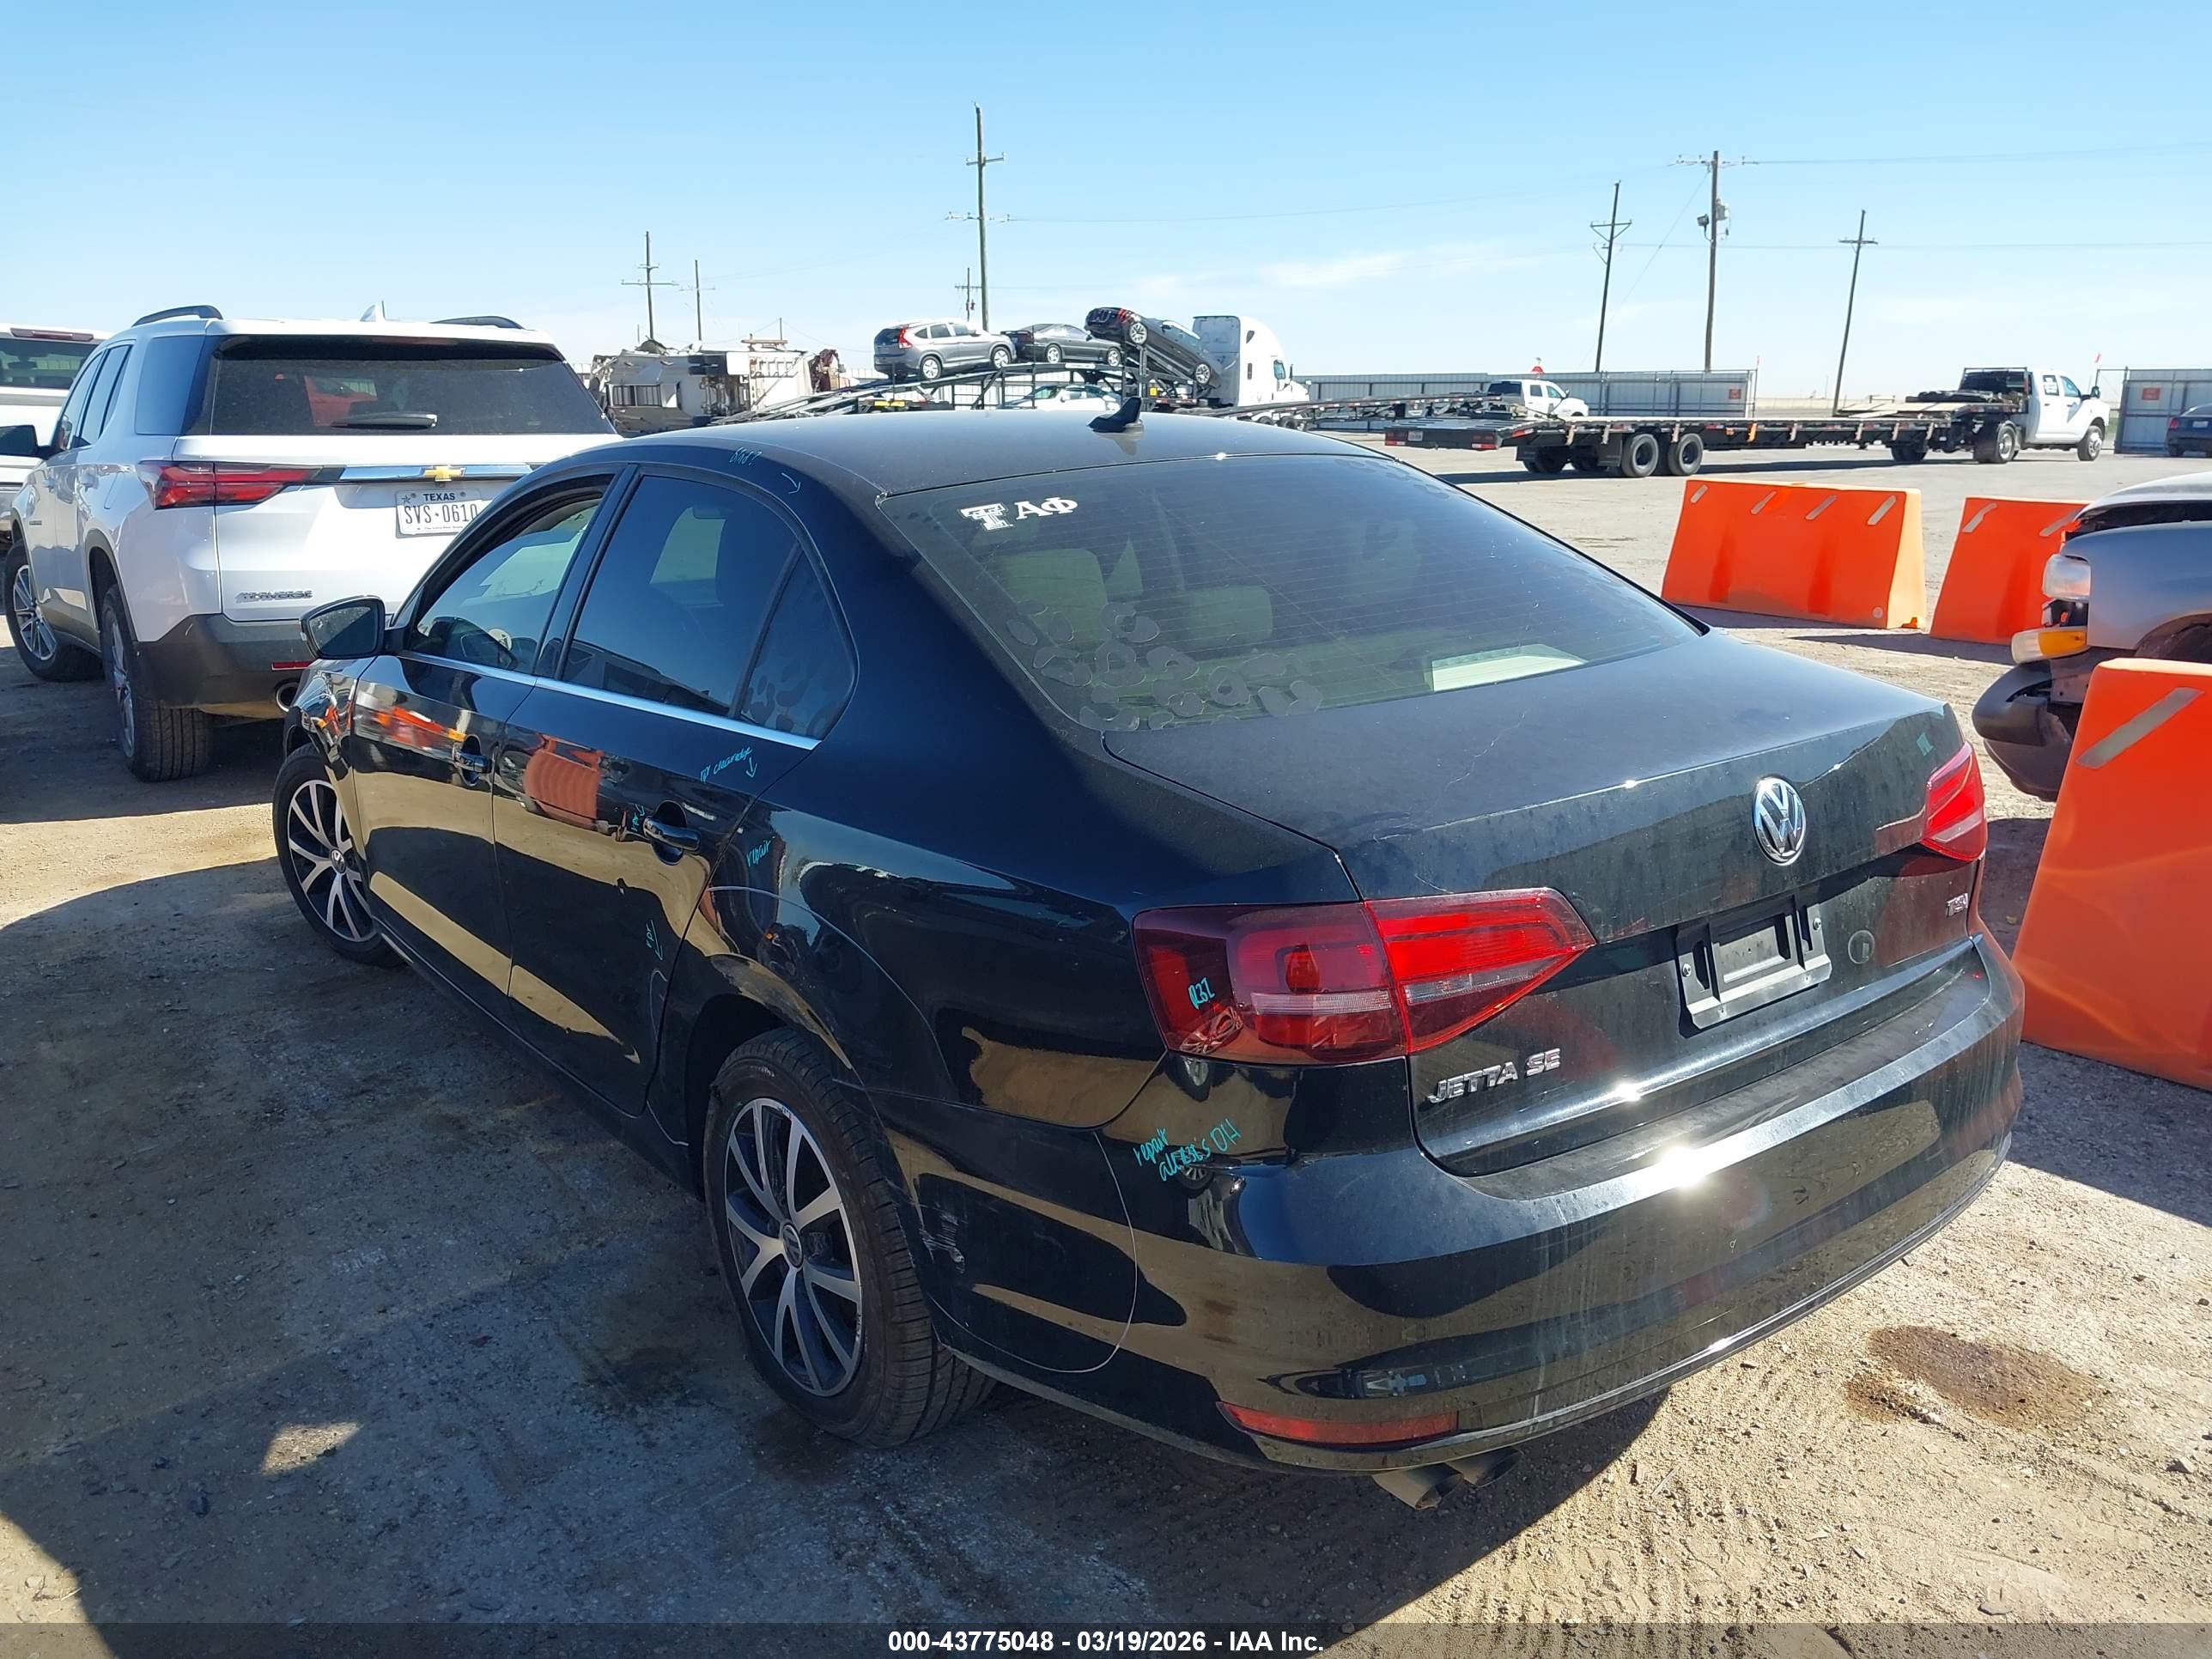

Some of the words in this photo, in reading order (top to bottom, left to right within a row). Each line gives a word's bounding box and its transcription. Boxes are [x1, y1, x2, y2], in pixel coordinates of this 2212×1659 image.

[422, 492, 456, 501] TEXAS
[1427, 1060, 1519, 1104] JETTA
[1525, 1047, 1561, 1077] SE
[1133, 1127, 1169, 1167] repair
